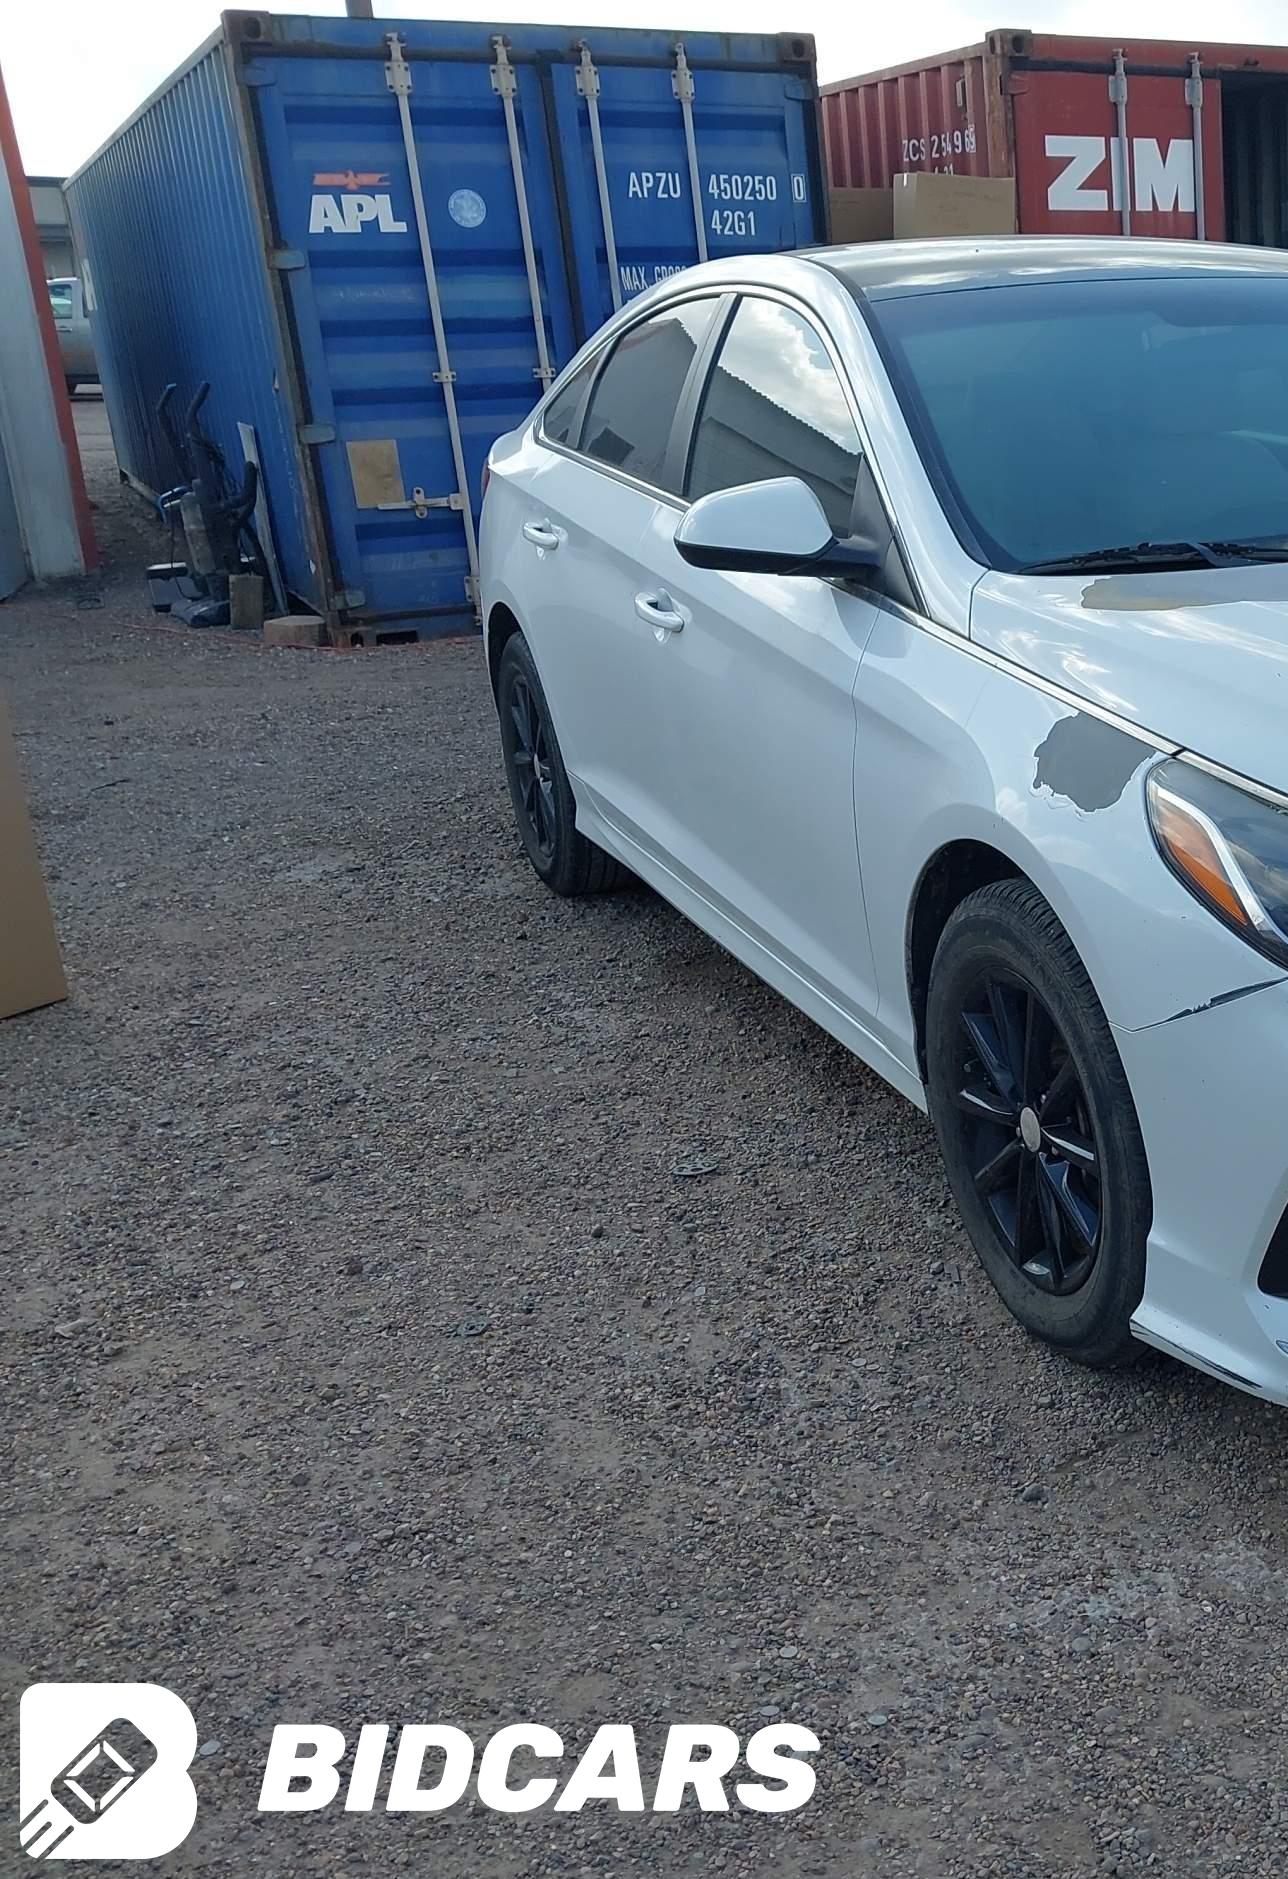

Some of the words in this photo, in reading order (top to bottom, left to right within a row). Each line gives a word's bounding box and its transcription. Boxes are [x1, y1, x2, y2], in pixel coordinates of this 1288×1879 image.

[628, 172, 681, 199] APZU
[708, 174, 777, 201] 450250
[1045, 135, 1195, 212] ZIM
[309, 194, 407, 233] APL
[711, 210, 756, 236] 42G1
